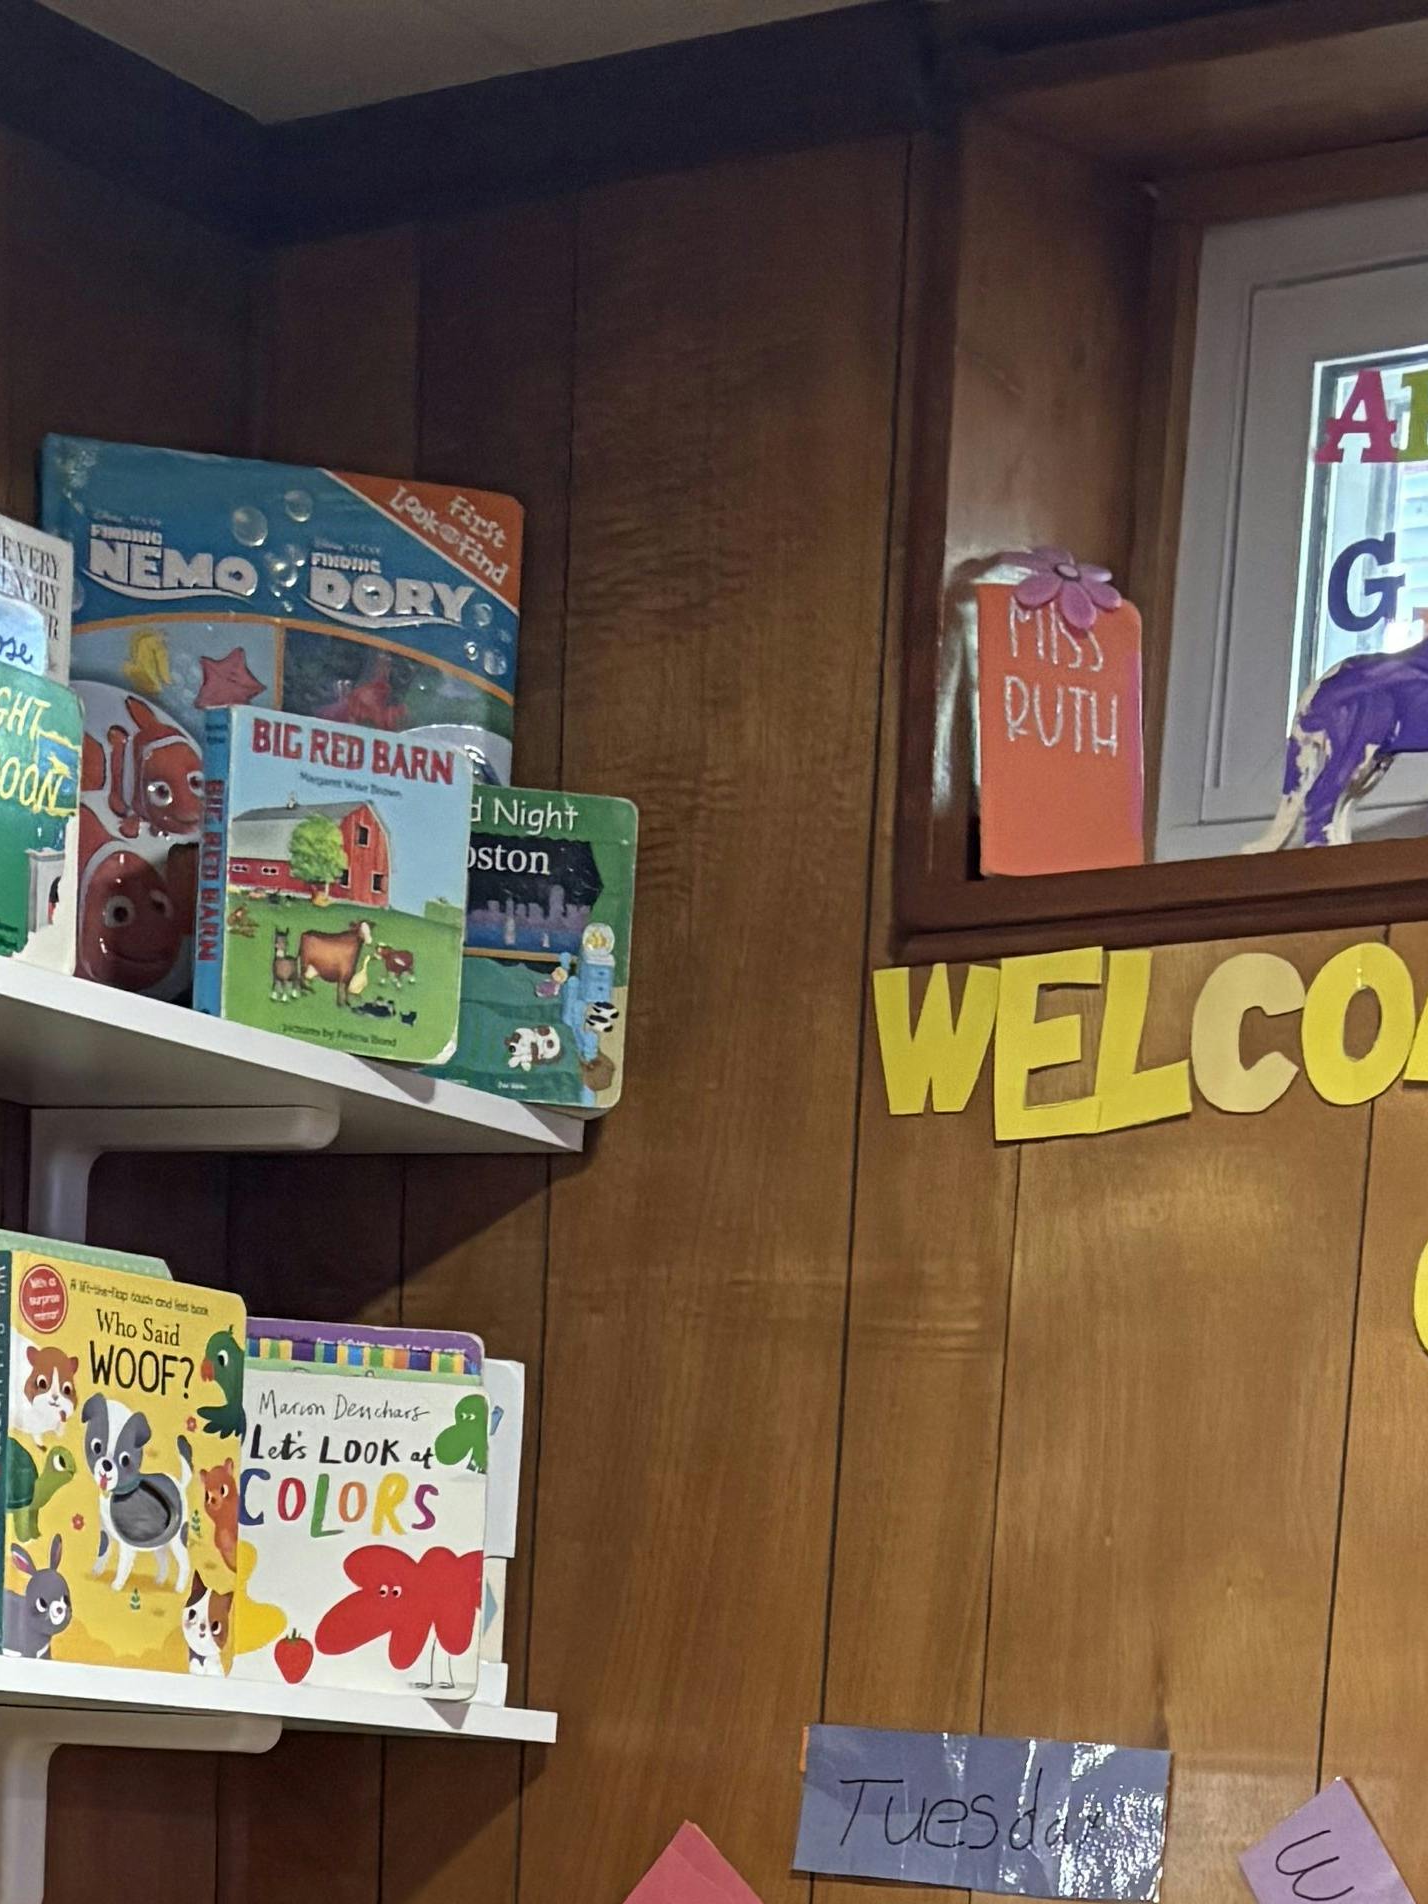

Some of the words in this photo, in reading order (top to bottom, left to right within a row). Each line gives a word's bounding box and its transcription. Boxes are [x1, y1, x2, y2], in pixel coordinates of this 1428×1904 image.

[449, 495, 507, 548] First
[88, 539, 259, 596] NEMO
[308, 569, 475, 624] DORY
[1008, 600, 1107, 675] MISS
[1003, 682, 1120, 759] RUTH
[252, 718, 302, 760] BIG
[310, 727, 365, 770] RED
[372, 739, 454, 786] BARN
[493, 800, 578, 836] Night
[96, 1308, 138, 1339] Who
[142, 1317, 181, 1347] Said
[89, 1340, 194, 1399] WOOF?
[249, 1424, 308, 1461] Let's
[319, 1436, 400, 1466] LOOK
[410, 1446, 434, 1470] at
[238, 1468, 439, 1538] COLORS
